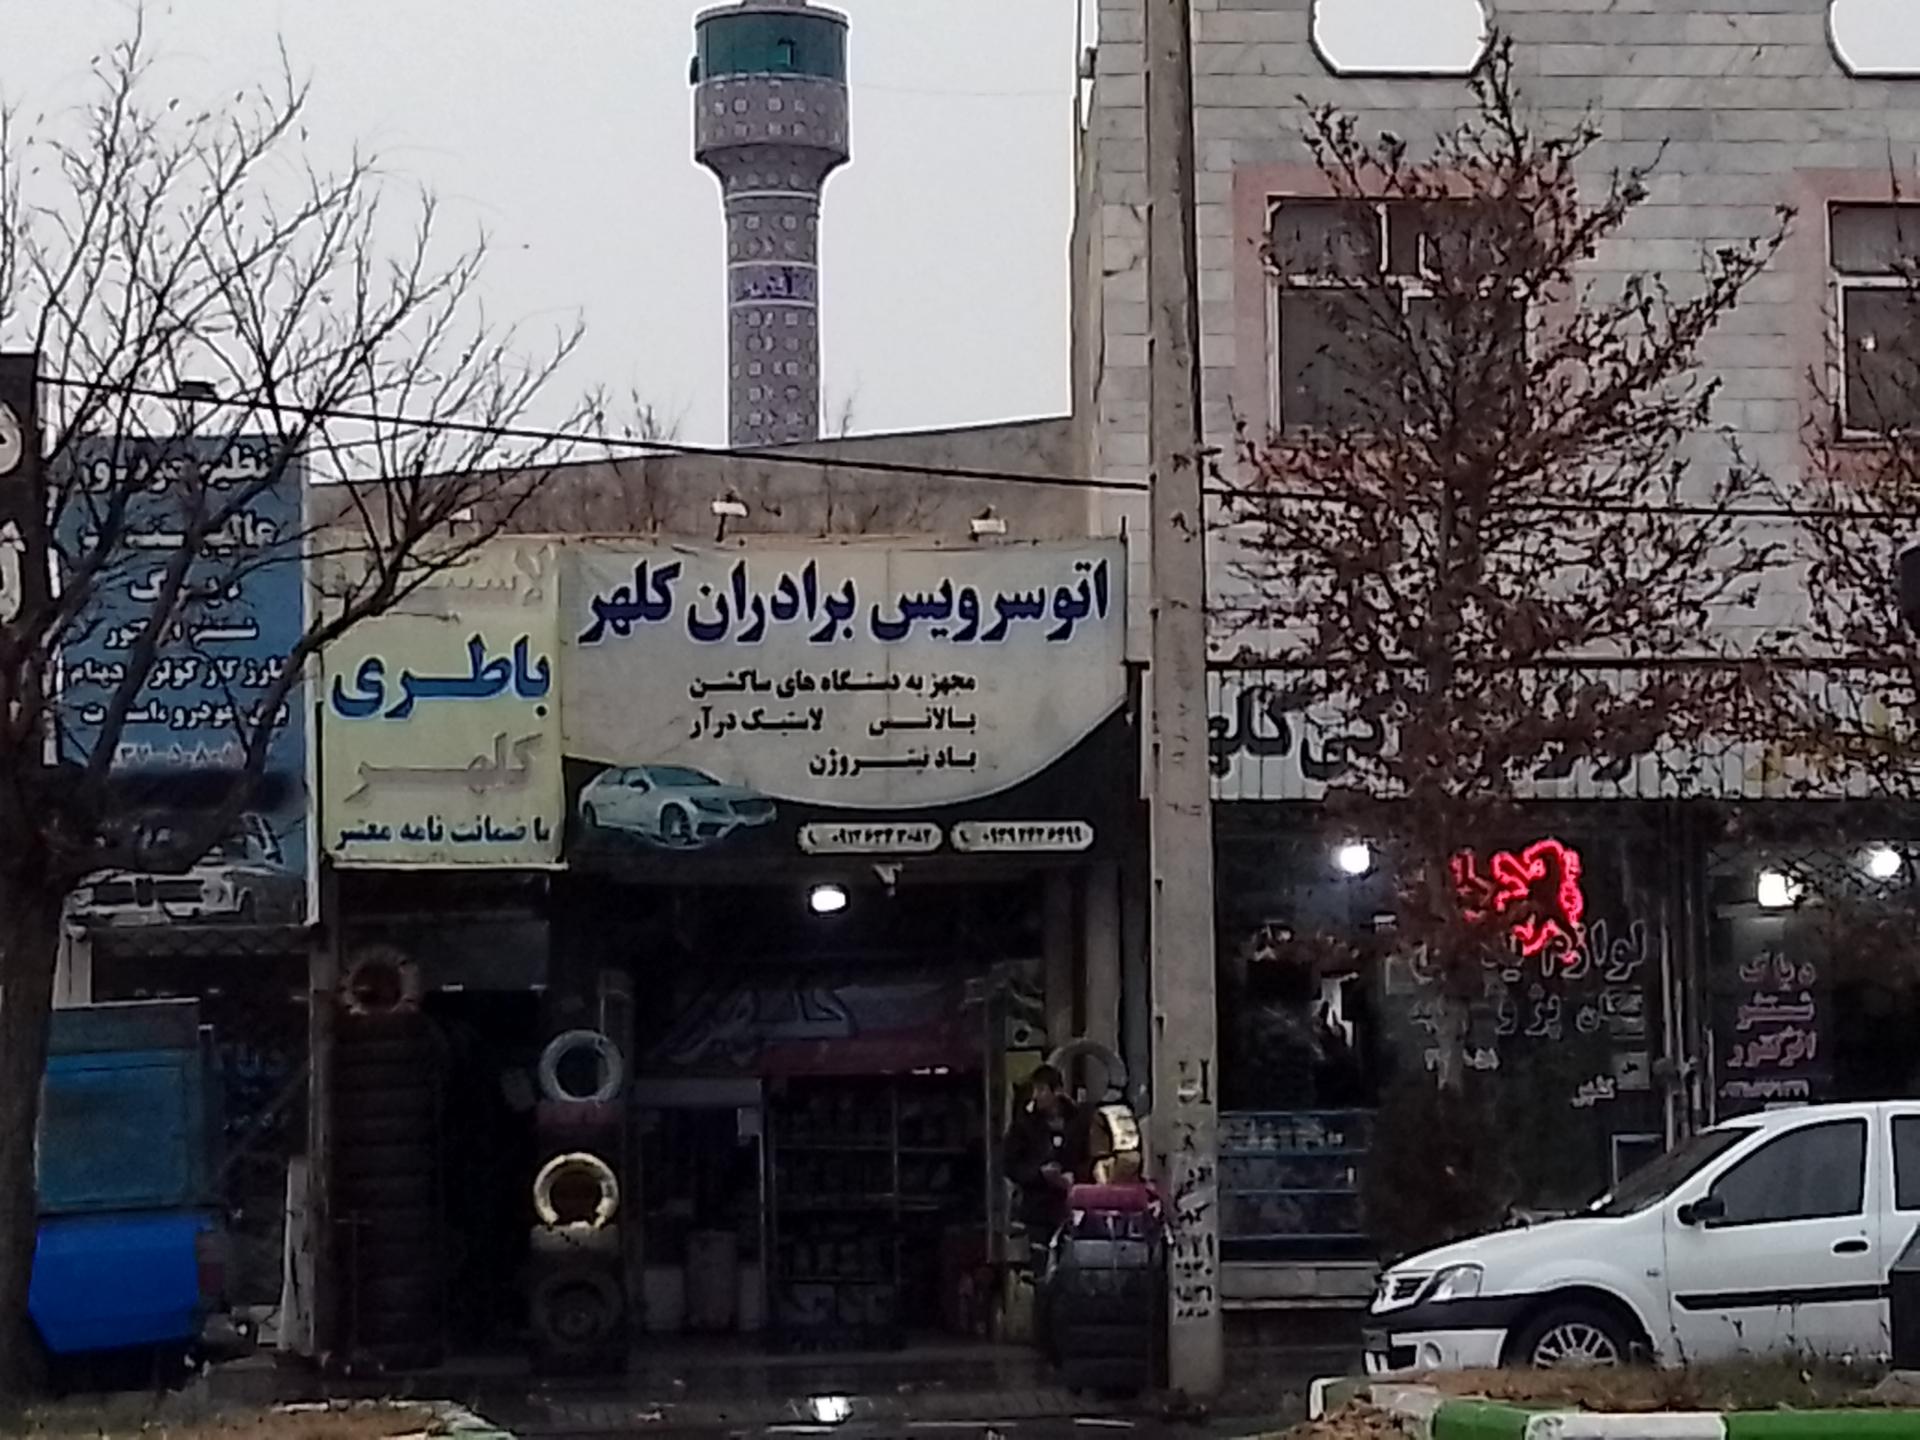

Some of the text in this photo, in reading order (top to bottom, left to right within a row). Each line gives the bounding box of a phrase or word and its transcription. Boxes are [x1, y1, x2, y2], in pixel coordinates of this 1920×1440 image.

[577, 558, 1110, 644] اتوسرویس برادران کلهر
[332, 633, 551, 720] باطری
[776, 669, 816, 700] های
[820, 669, 901, 692] دستگاه
[905, 673, 924, 697] به
[931, 671, 977, 699] مجهز
[740, 707, 824, 738] لاستیک
[868, 707, 978, 737] بالانس
[808, 746, 978, 778] باد نیتروژن
[334, 814, 551, 852] با ضمانت نامه معتبر
